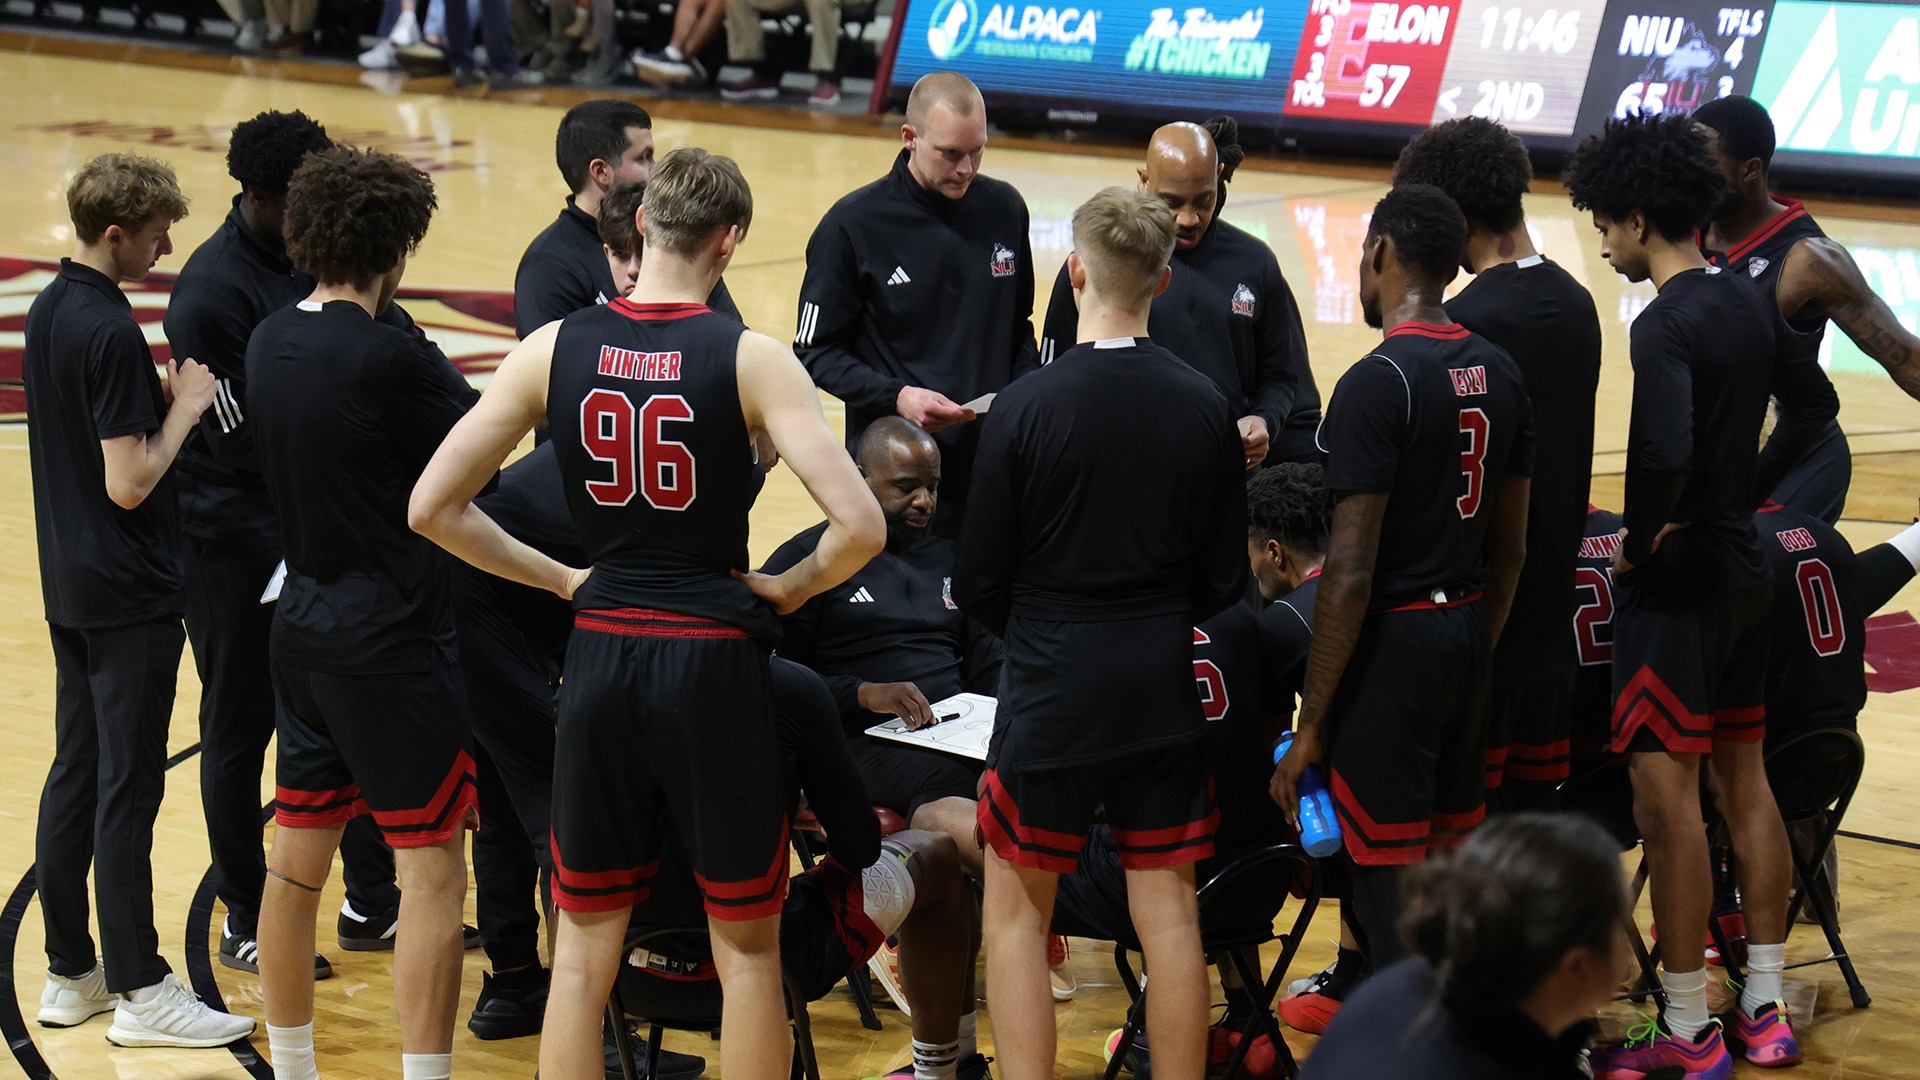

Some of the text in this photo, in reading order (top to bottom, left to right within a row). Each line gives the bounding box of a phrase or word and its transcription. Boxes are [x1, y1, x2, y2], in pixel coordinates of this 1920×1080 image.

[979, 3, 1098, 46] ALPACA
[1314, 14, 1335, 48] 3
[1365, 2, 1450, 46] ELON
[1480, 6, 1581, 54] 11:46
[1618, 14, 1685, 56] NIU
[1717, 7, 1766, 38] TFLS
[1723, 35, 1746, 71] 4
[1291, 79, 1326, 108] TOL
[1358, 63, 1412, 109] 57
[1471, 79, 1545, 122] 2ND
[1614, 81, 1669, 119] 65
[991, 260, 1015, 274] NIU
[597, 344, 682, 381] WINTHER
[579, 387, 697, 512] 96
[1456, 407, 1490, 520] 3
[1776, 527, 1817, 552] COBB
[1795, 558, 1846, 657] 0
